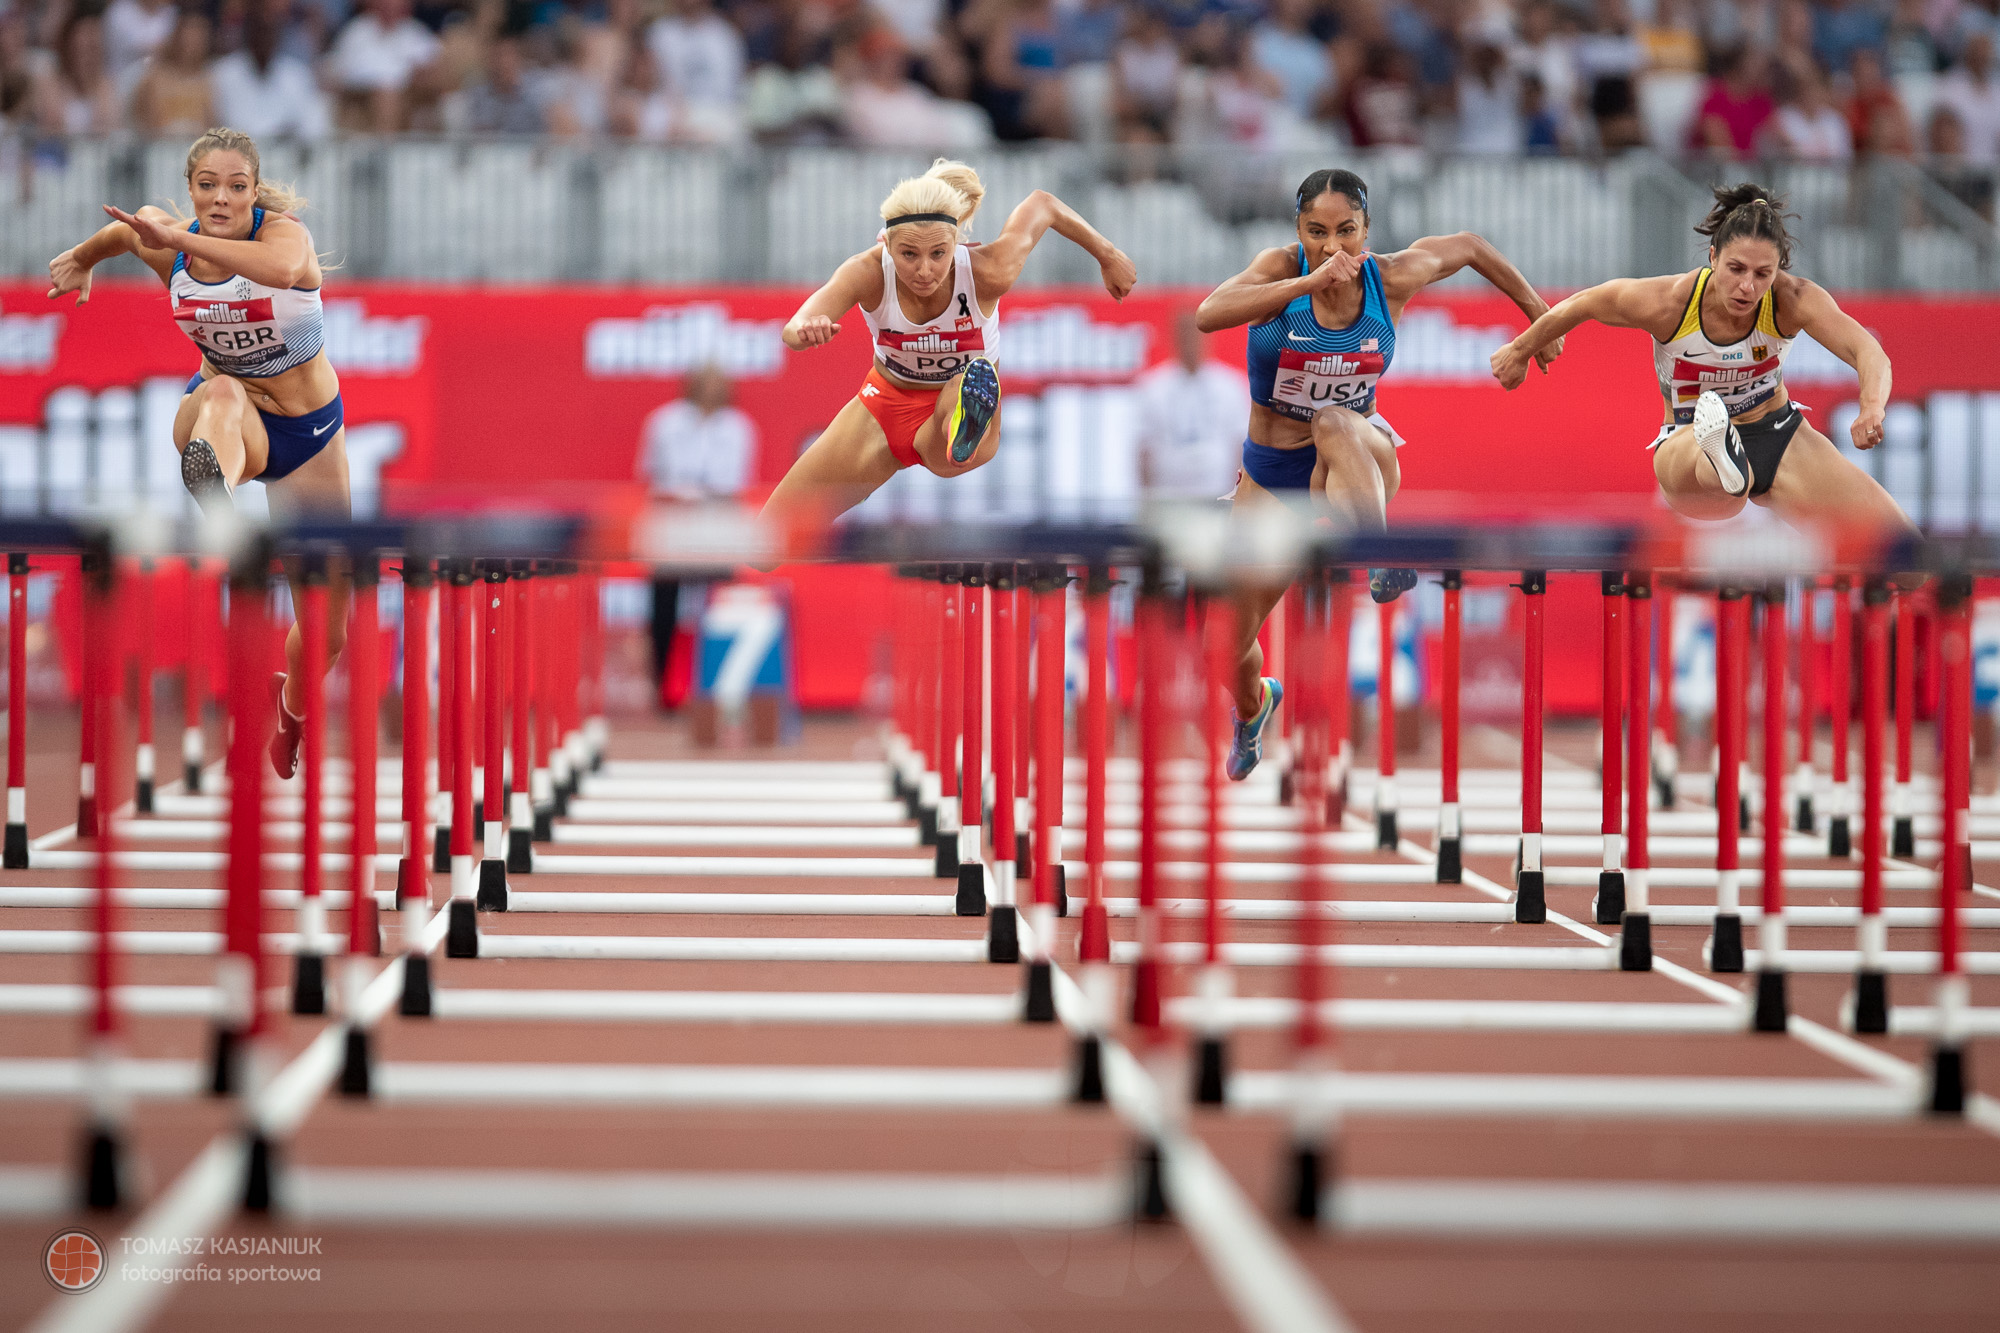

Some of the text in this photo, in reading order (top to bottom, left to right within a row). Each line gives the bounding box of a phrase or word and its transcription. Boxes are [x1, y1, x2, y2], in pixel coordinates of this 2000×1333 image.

[194, 303, 248, 323] müller
[212, 326, 278, 350] GBR
[901, 333, 959, 353] müller
[240, 350, 267, 362] WORLD
[1303, 354, 1360, 376] müller
[1722, 352, 1743, 361] DKB
[1698, 368, 1756, 382] müller
[1309, 380, 1368, 402] USA
[1290, 406, 1315, 417] ATHLE
[1352, 398, 1365, 408] CUP
[703, 594, 783, 706] 7
